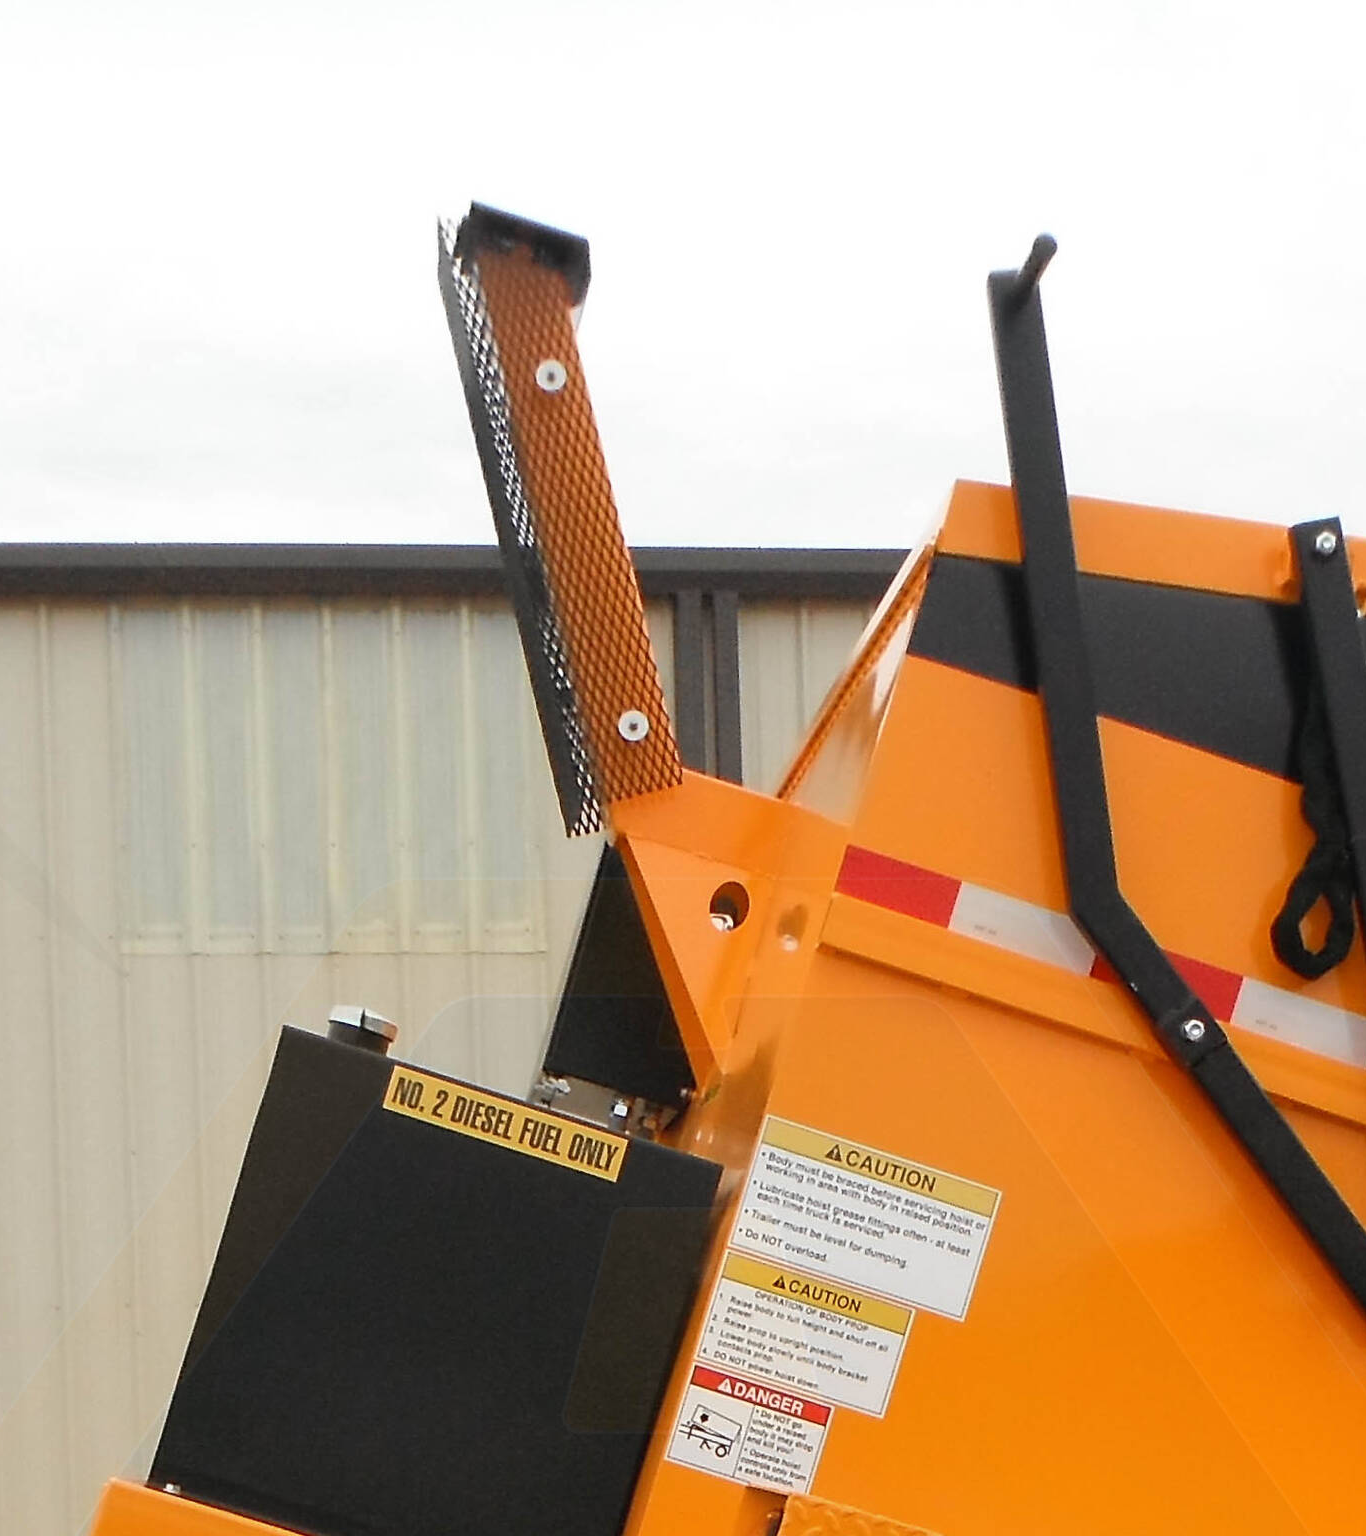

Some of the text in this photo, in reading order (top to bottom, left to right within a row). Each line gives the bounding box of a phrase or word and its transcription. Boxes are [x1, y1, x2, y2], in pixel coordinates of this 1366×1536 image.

[391, 1077, 619, 1171] NO. 2 DIESEL FUEL ONLY
[846, 1150, 936, 1193] CAUTION
[757, 1192, 780, 1205] each
[782, 1199, 804, 1212] time
[805, 1207, 829, 1221] truck
[832, 1215, 841, 1225] is
[766, 1164, 804, 1183] working
[806, 1176, 816, 1185] in
[817, 1181, 839, 1193] area
[841, 1189, 861, 1199] with
[863, 1194, 887, 1210] body
[889, 1203, 899, 1212] in
[901, 1208, 931, 1224] raised
[768, 1152, 986, 1231] Body must be braced before servicing hoist or
[752, 1209, 781, 1225] Trailer
[783, 1221, 808, 1235] must
[809, 1228, 822, 1240] be
[823, 1233, 847, 1248] level
[849, 1241, 863, 1252] for
[759, 1181, 805, 1203] Lubricate
[806, 1196, 831, 1213] hoist
[833, 1206, 866, 1223] grease
[867, 1216, 901, 1234] fittings
[903, 1229, 928, 1242] often
[935, 1240, 945, 1249] at
[947, 1242, 970, 1257] least
[745, 1228, 759, 1240] Do
[761, 1233, 783, 1248] NOT
[755, 1291, 804, 1312] OPERATION
[805, 1307, 817, 1315] OF
[819, 1311, 843, 1324] BODY
[789, 1280, 862, 1313] CAUTION
[713, 1350, 727, 1361] DO
[729, 1355, 747, 1366] NOT
[734, 1382, 804, 1416] DANGER
[773, 1414, 791, 1425] NOT
